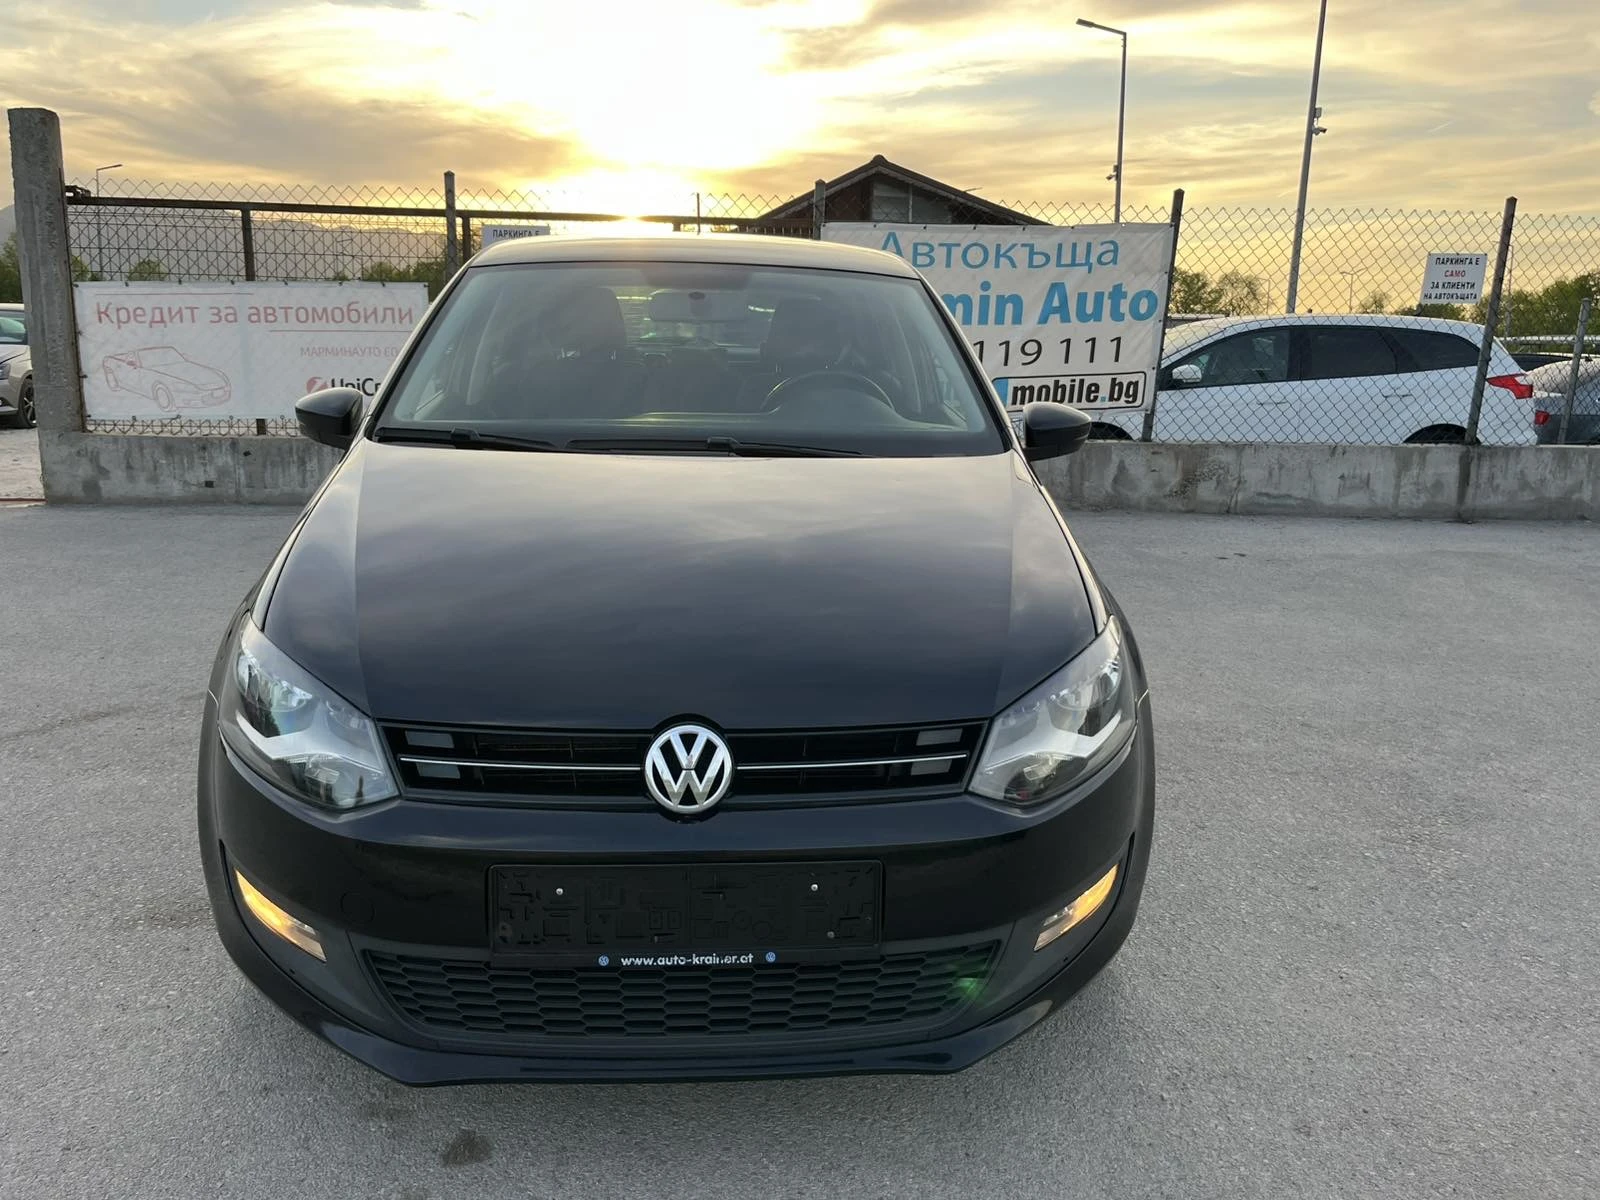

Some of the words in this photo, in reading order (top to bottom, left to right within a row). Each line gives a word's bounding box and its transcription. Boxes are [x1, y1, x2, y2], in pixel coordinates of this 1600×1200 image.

[493, 229, 533, 239] ПАРКИНГА
[882, 232, 1119, 273] Автокъща
[1435, 257, 1473, 265] ПАРКИНГА
[1475, 257, 1480, 265] Е
[96, 302, 200, 329] Кредит
[209, 306, 238, 324] за
[247, 301, 413, 324] автомобили
[1037, 281, 1158, 325] Auto
[1060, 336, 1122, 364] 111
[1011, 377, 1139, 405] mobile.bg
